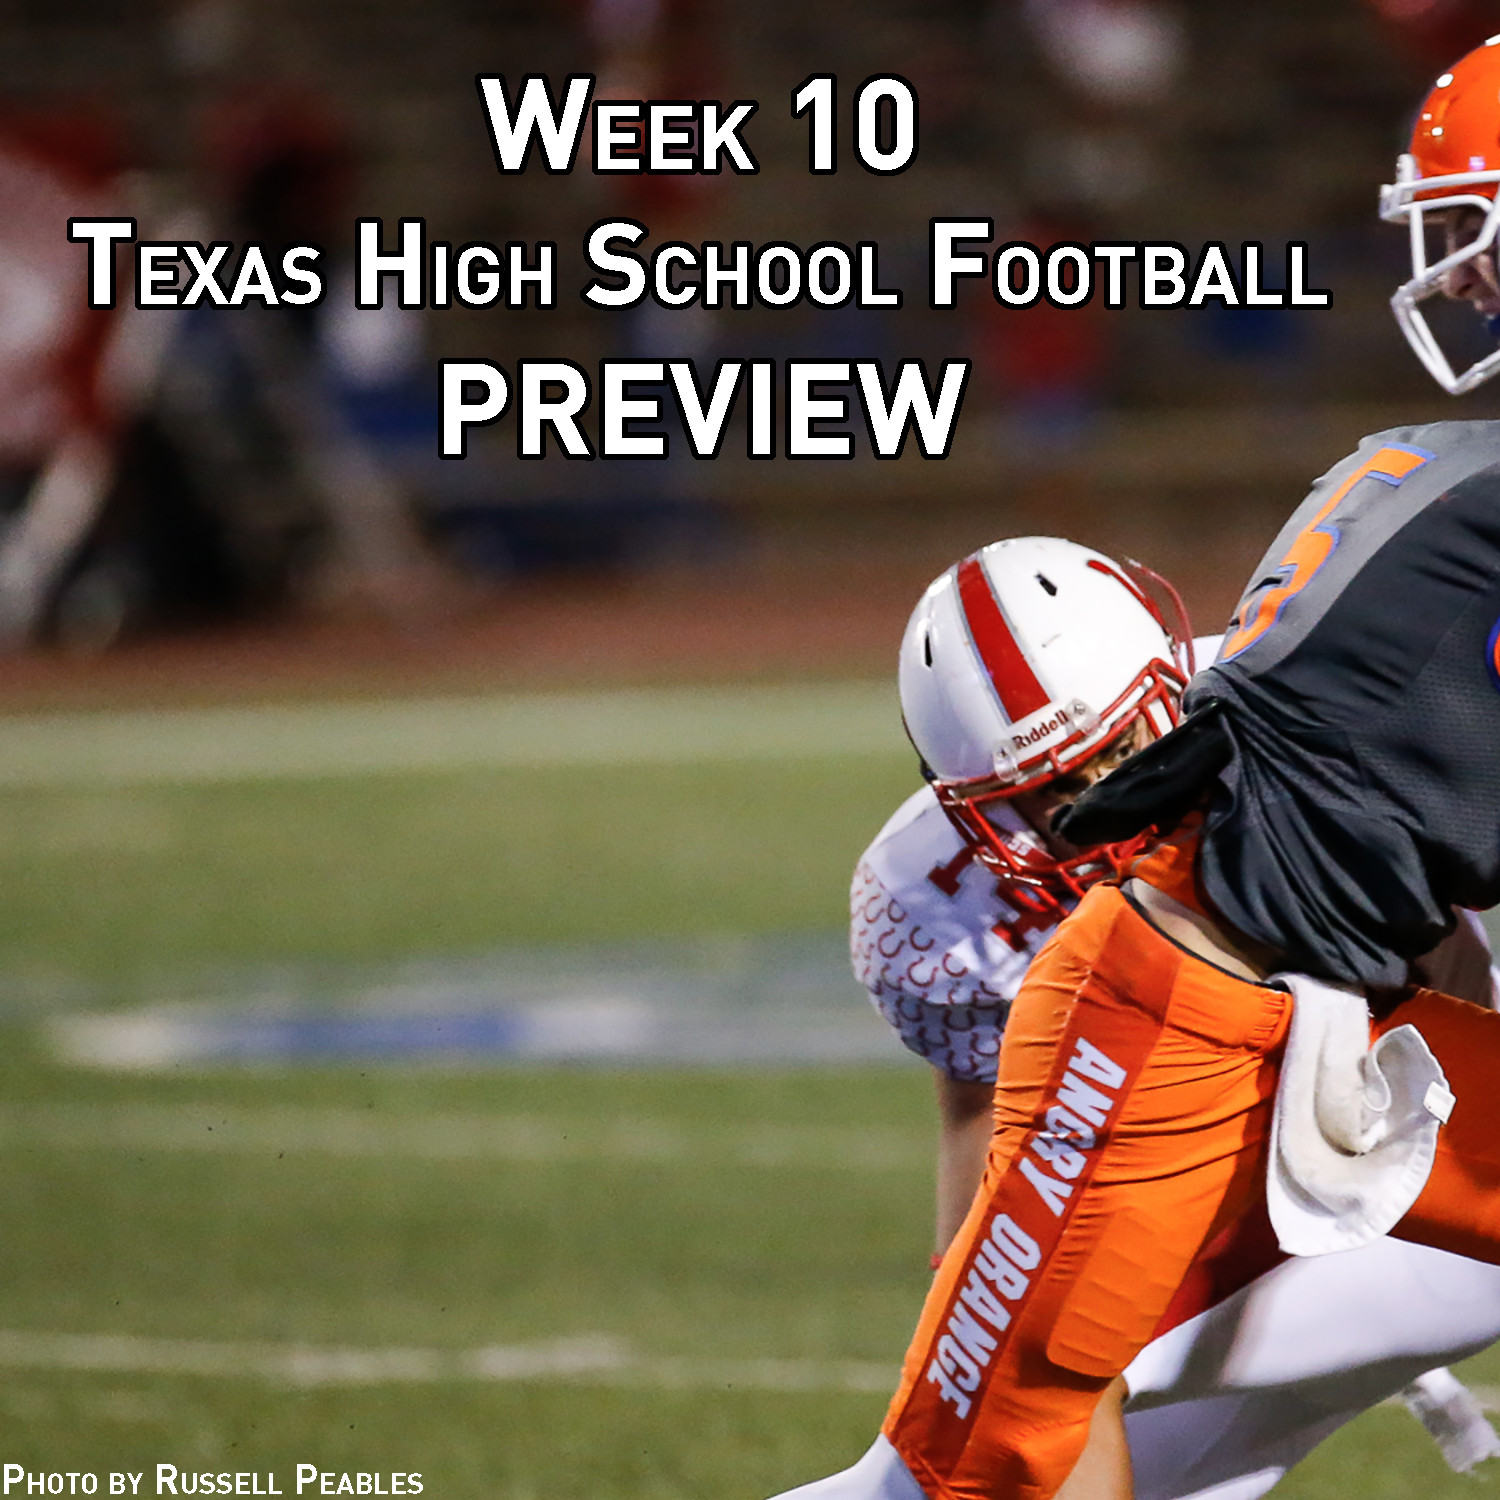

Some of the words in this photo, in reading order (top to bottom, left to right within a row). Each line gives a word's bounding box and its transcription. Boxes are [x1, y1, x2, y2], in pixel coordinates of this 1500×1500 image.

[1220, 442, 1436, 664] 5
[1012, 709, 1069, 750] Riddell
[1018, 1036, 1128, 1217] ANGRY
[926, 1212, 1042, 1420] ORANGE
